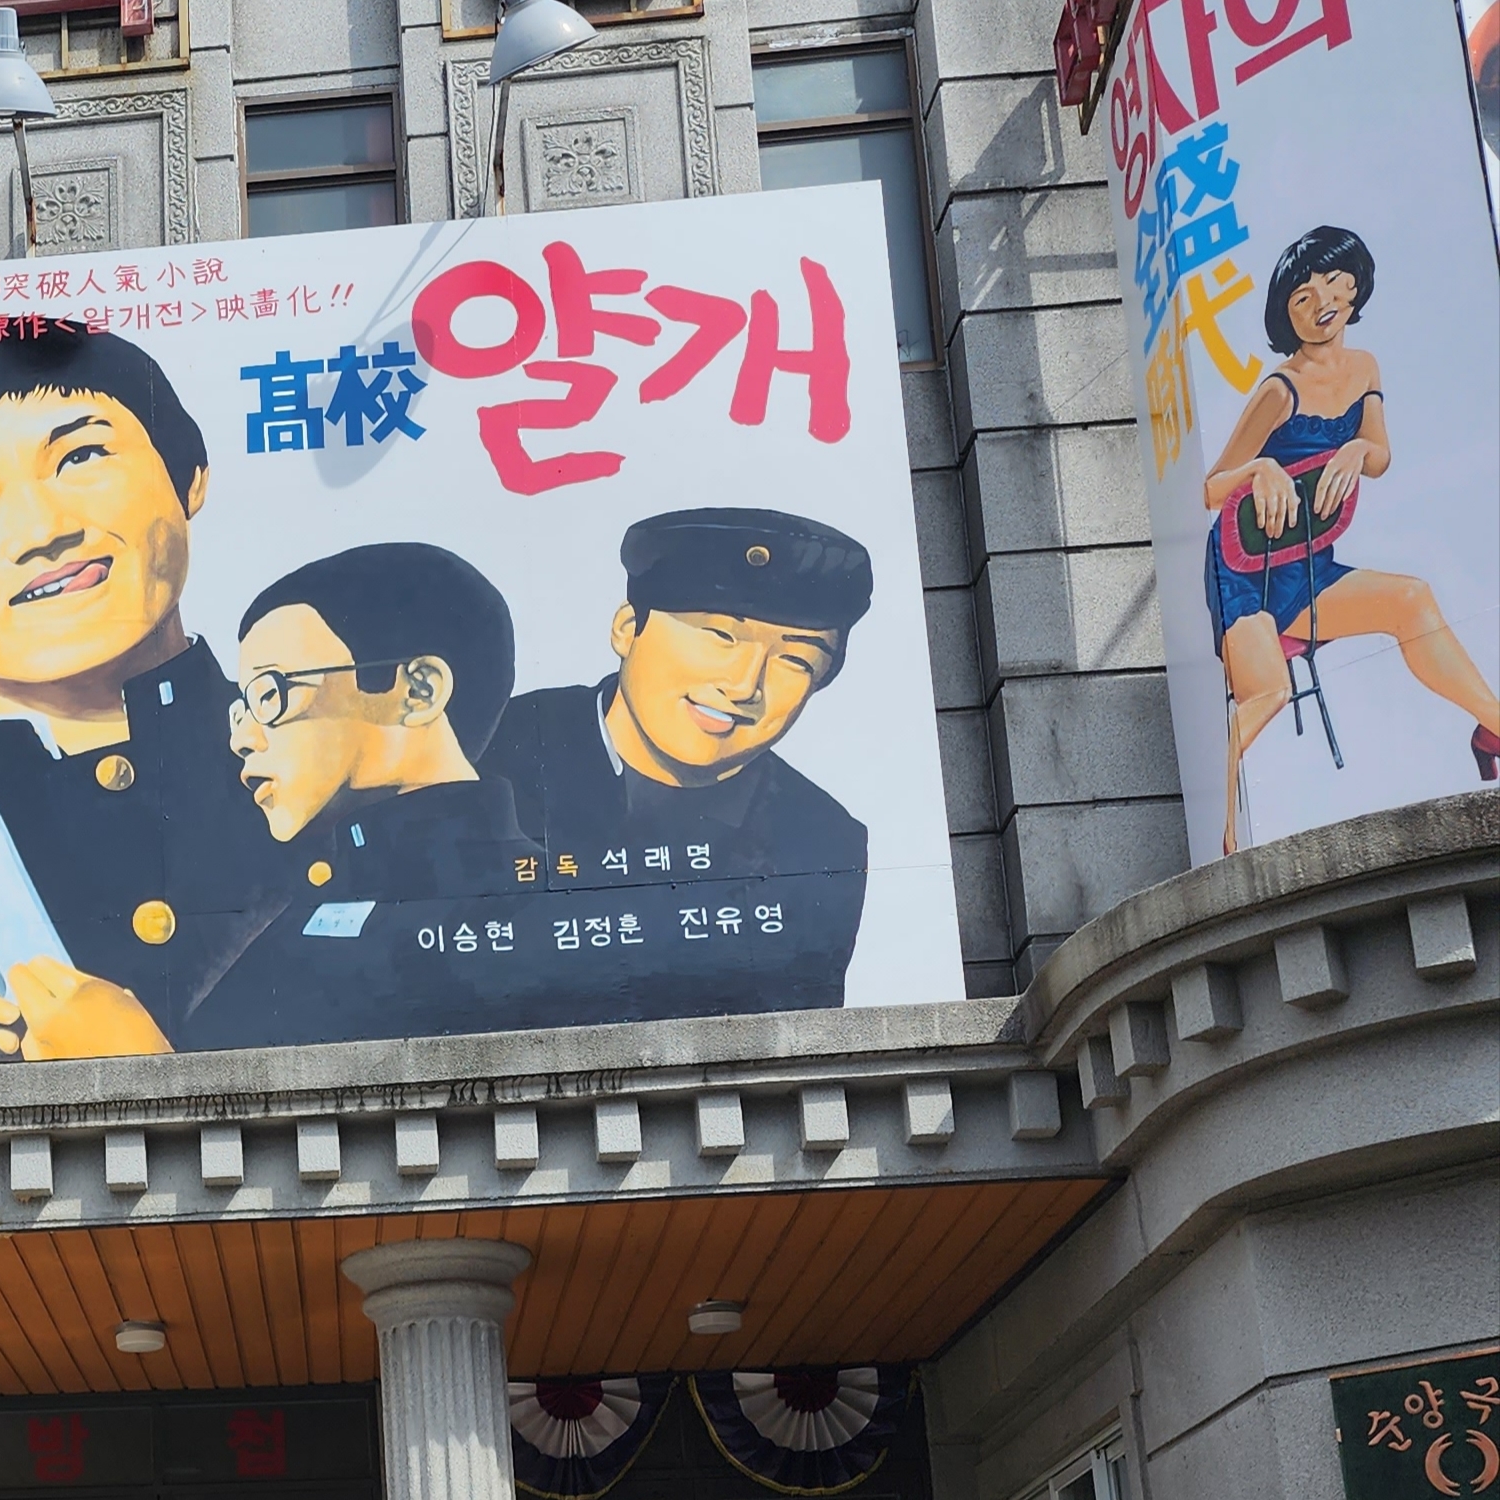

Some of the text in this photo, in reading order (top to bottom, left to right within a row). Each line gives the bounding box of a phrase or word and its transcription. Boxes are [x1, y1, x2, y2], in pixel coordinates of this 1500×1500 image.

[411, 240, 852, 496] 얄개
[514, 842, 712, 882] 감독 석래명
[417, 903, 785, 953] 이승현 김정훈 진유영
